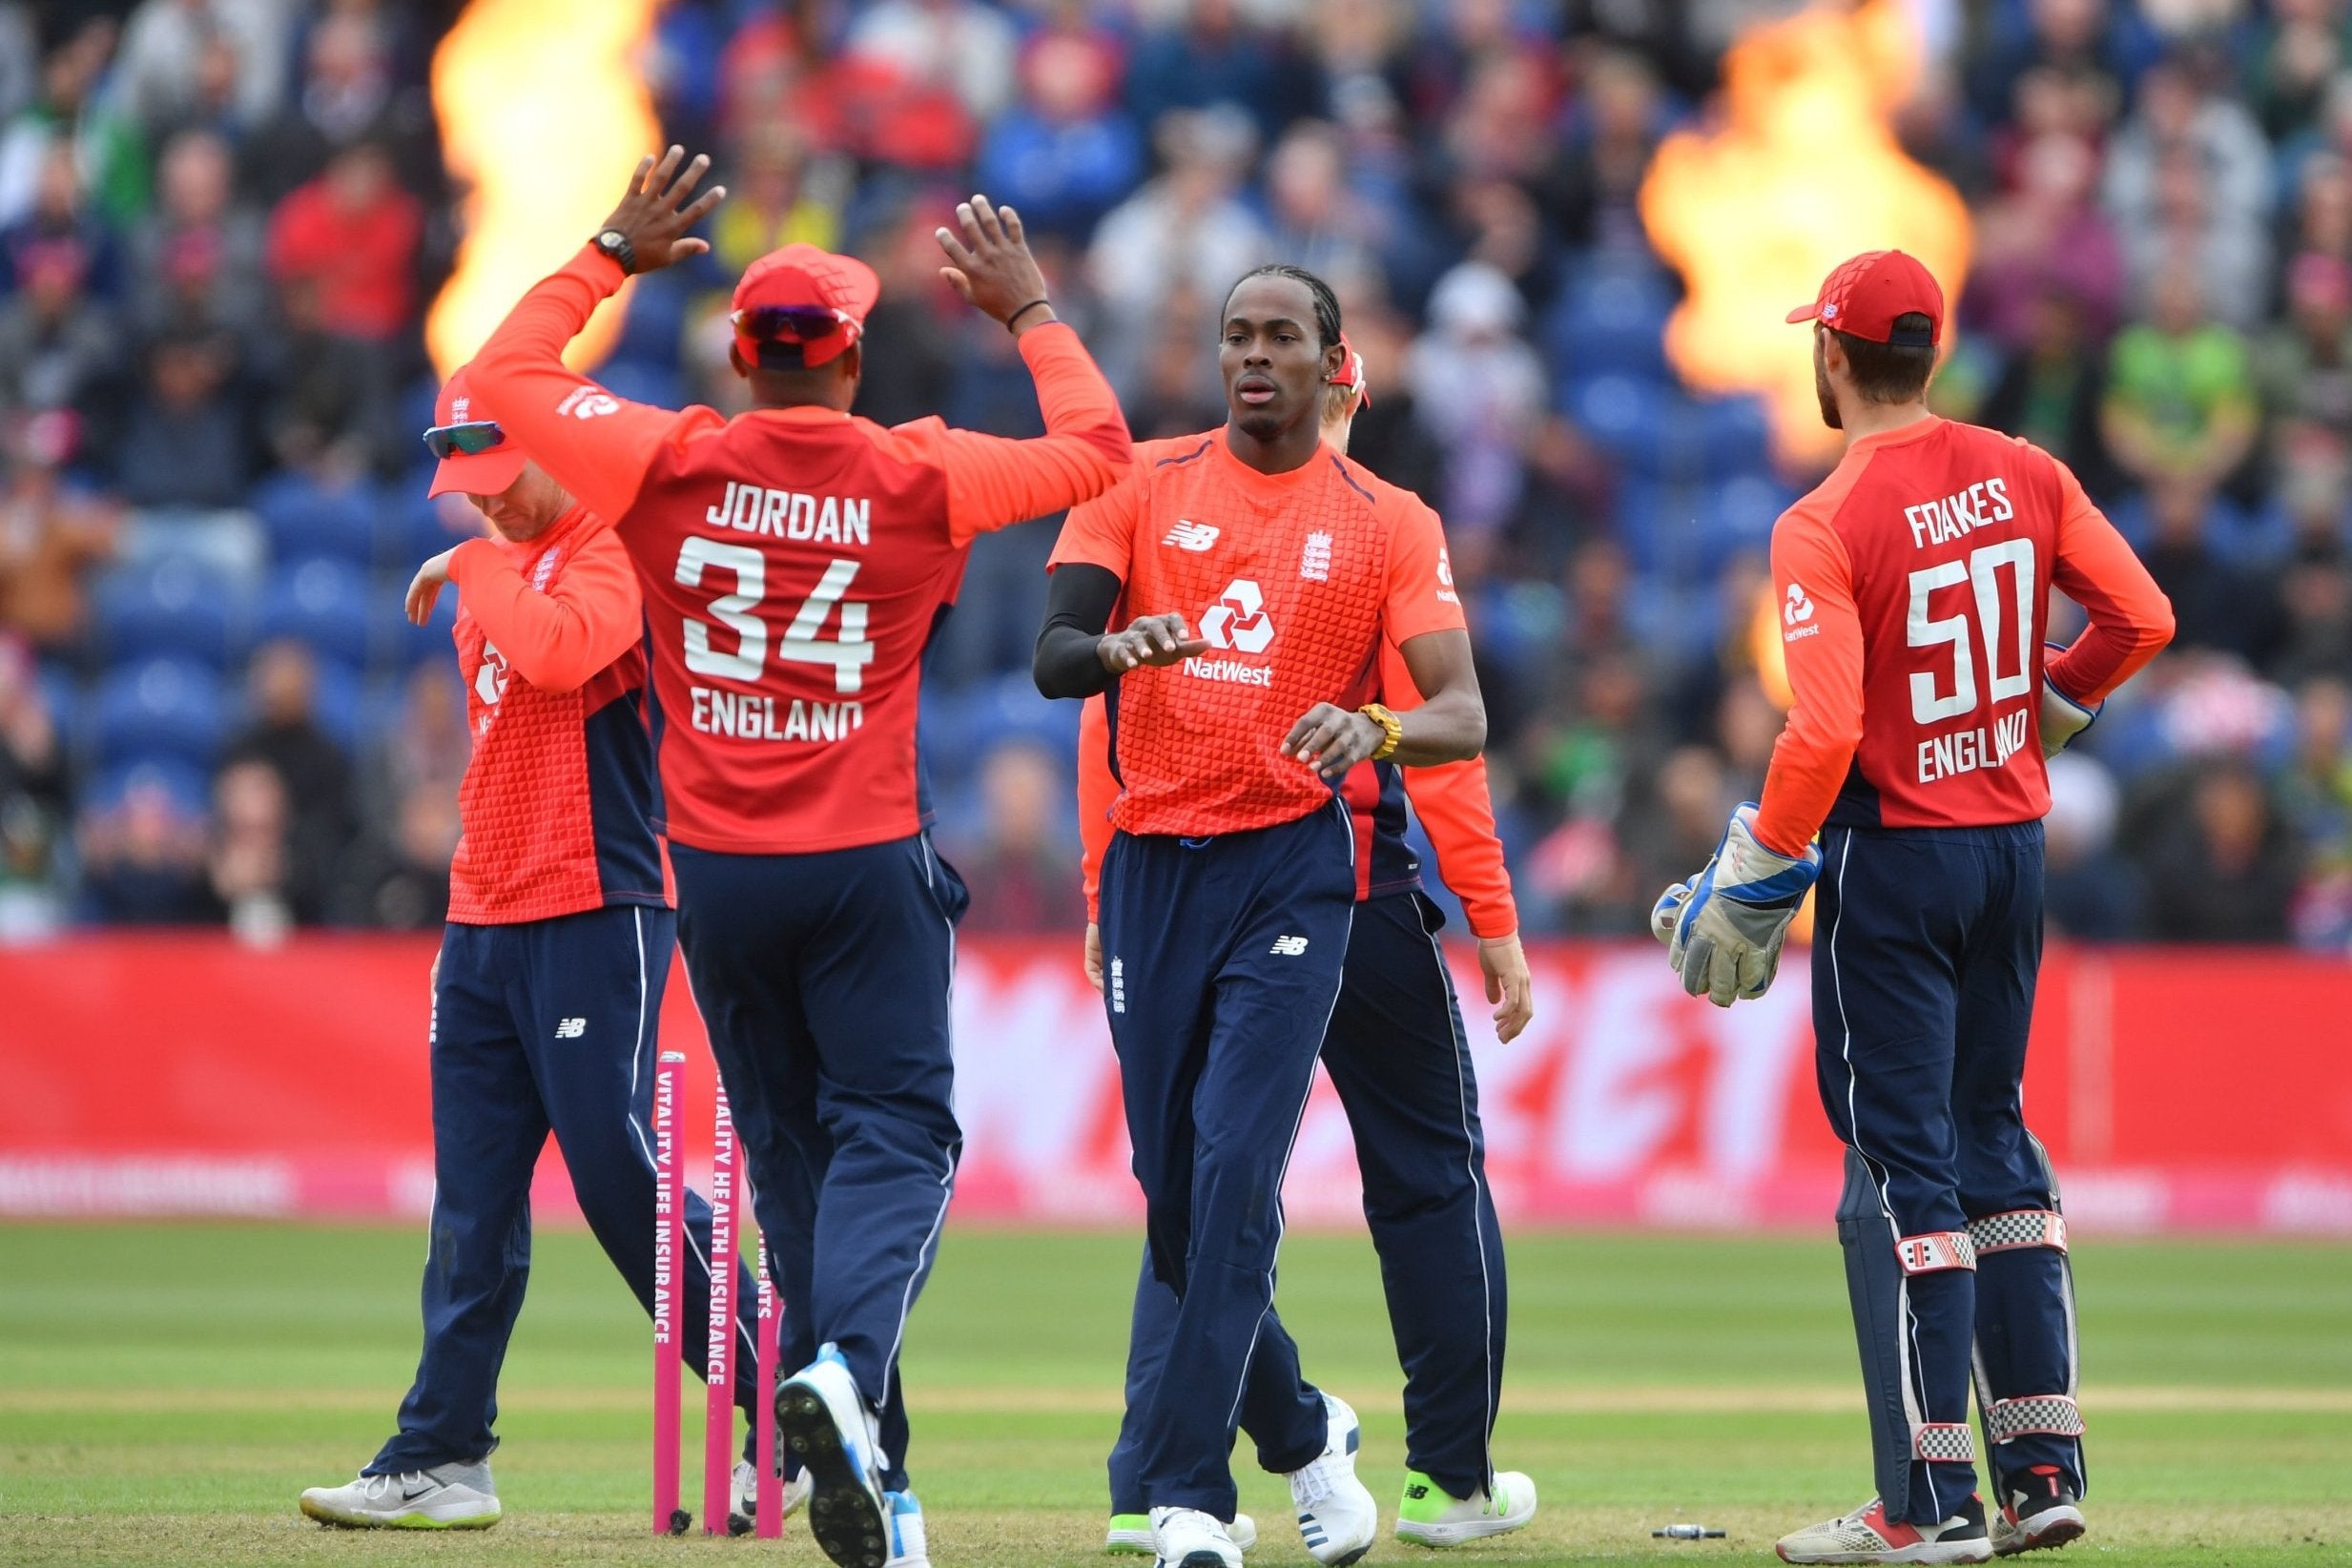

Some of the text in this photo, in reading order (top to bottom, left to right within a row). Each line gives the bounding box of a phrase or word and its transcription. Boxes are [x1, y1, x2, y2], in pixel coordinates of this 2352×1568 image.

[706, 481, 870, 546] JORDAN
[1904, 477, 2014, 549] FOAKES
[674, 535, 875, 693] 34
[1908, 538, 2035, 725] 50
[1183, 656, 1273, 688] NatWest
[690, 686, 863, 743] ENGLAND
[1917, 708, 2029, 784] ENGLAND
[654, 1070, 672, 1344] VITALITY LIFE INSURANCE
[712, 1171, 732, 1254] HEALTH
[708, 1261, 729, 1386] INSURANCE
